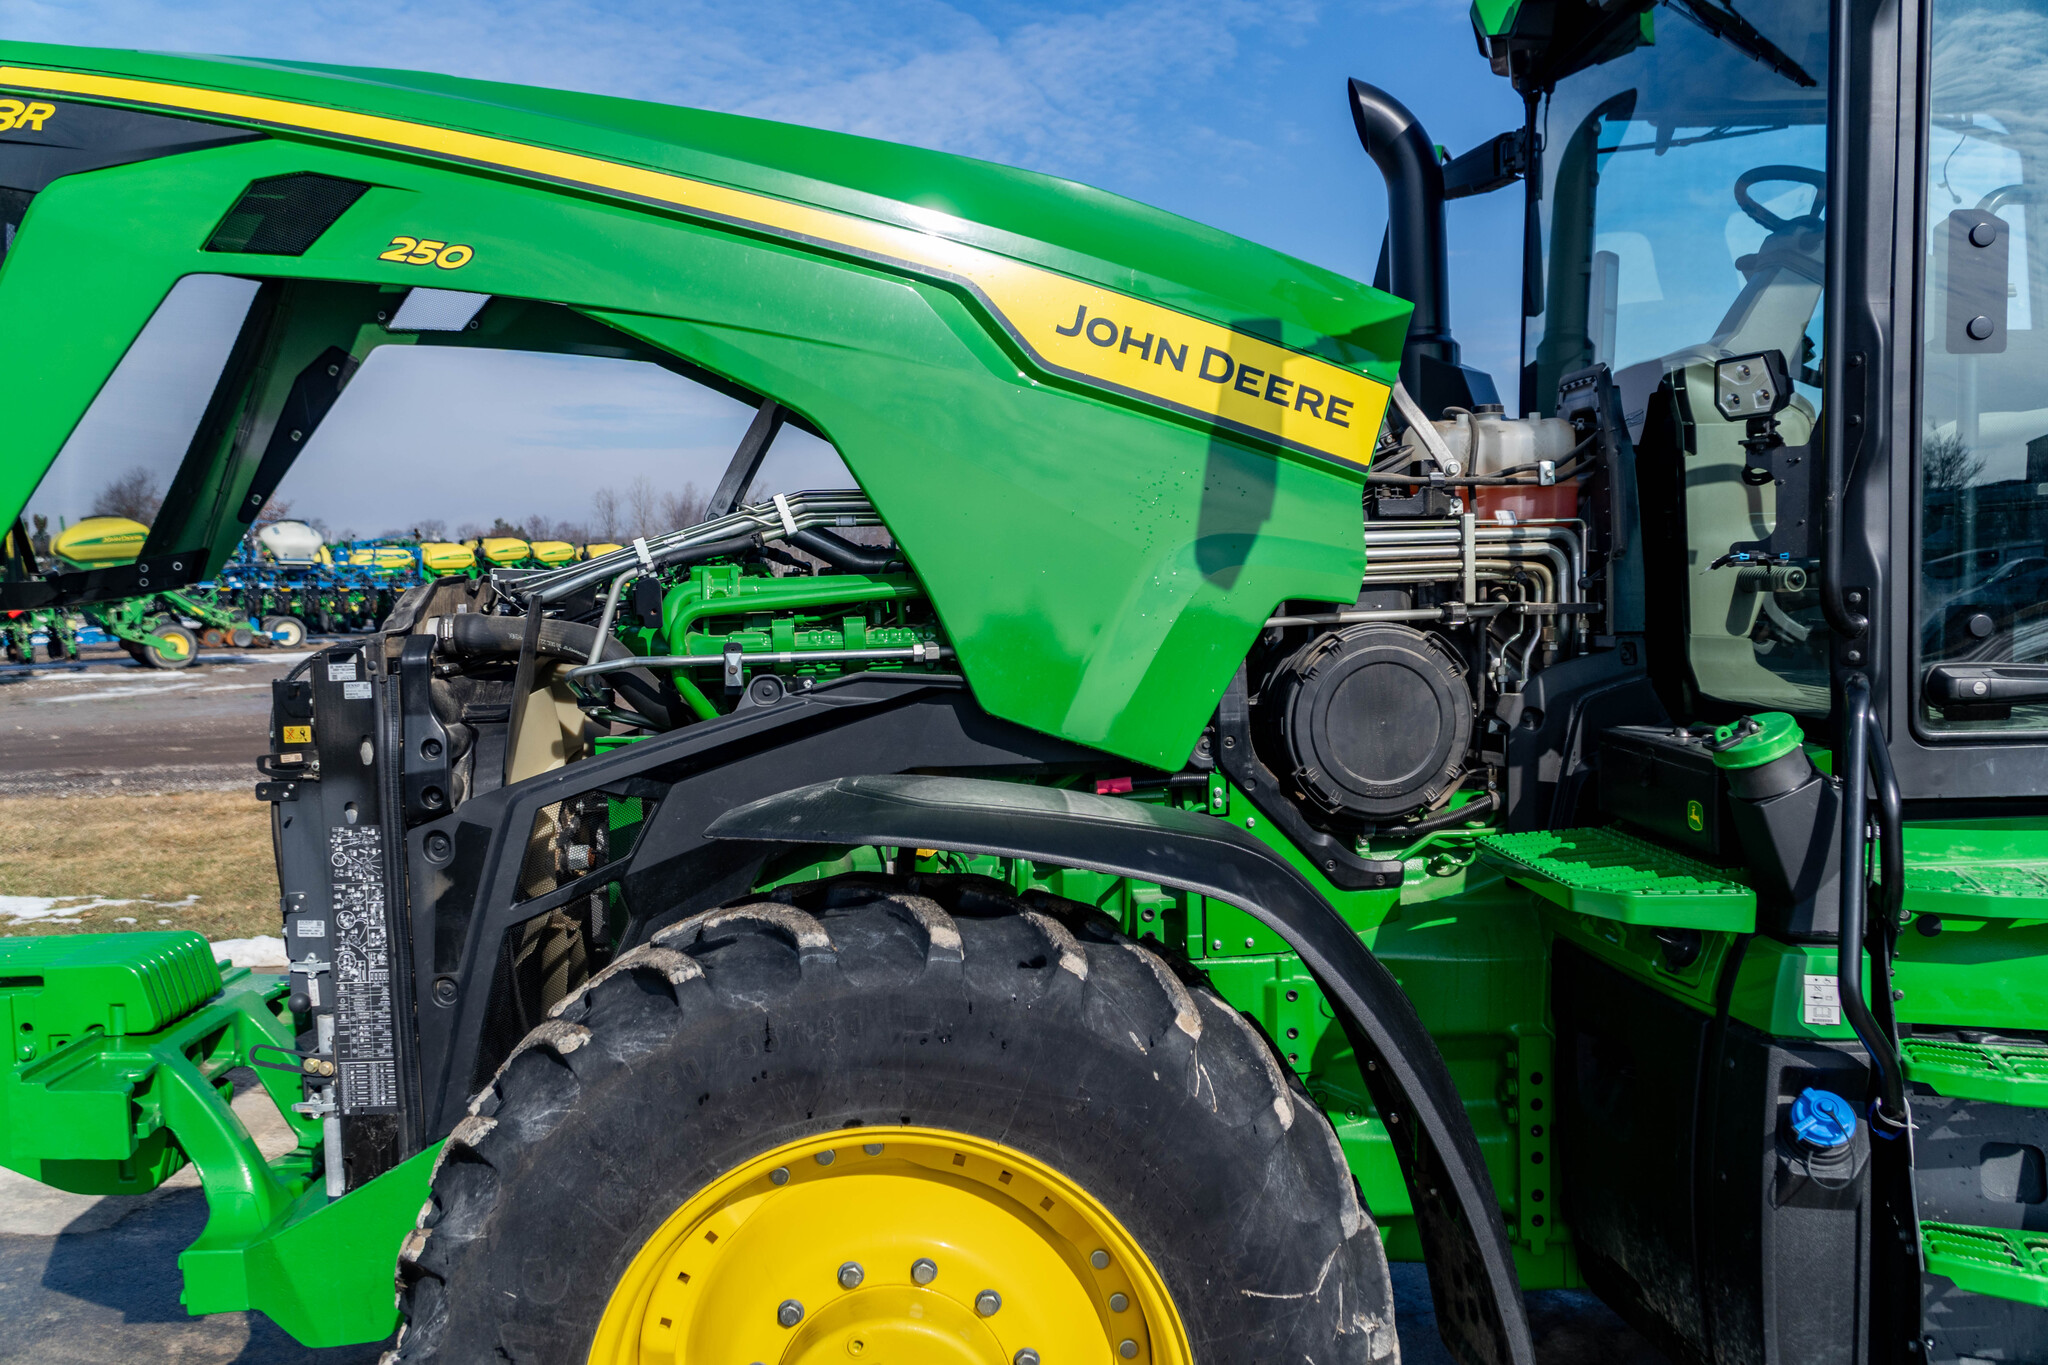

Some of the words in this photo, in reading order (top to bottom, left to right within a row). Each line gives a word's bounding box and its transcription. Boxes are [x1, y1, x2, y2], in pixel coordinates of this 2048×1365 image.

[0, 99, 56, 132] 8R
[377, 236, 475, 270] 250
[1055, 305, 1188, 372] JOHN
[1198, 346, 1354, 428] DEERE
